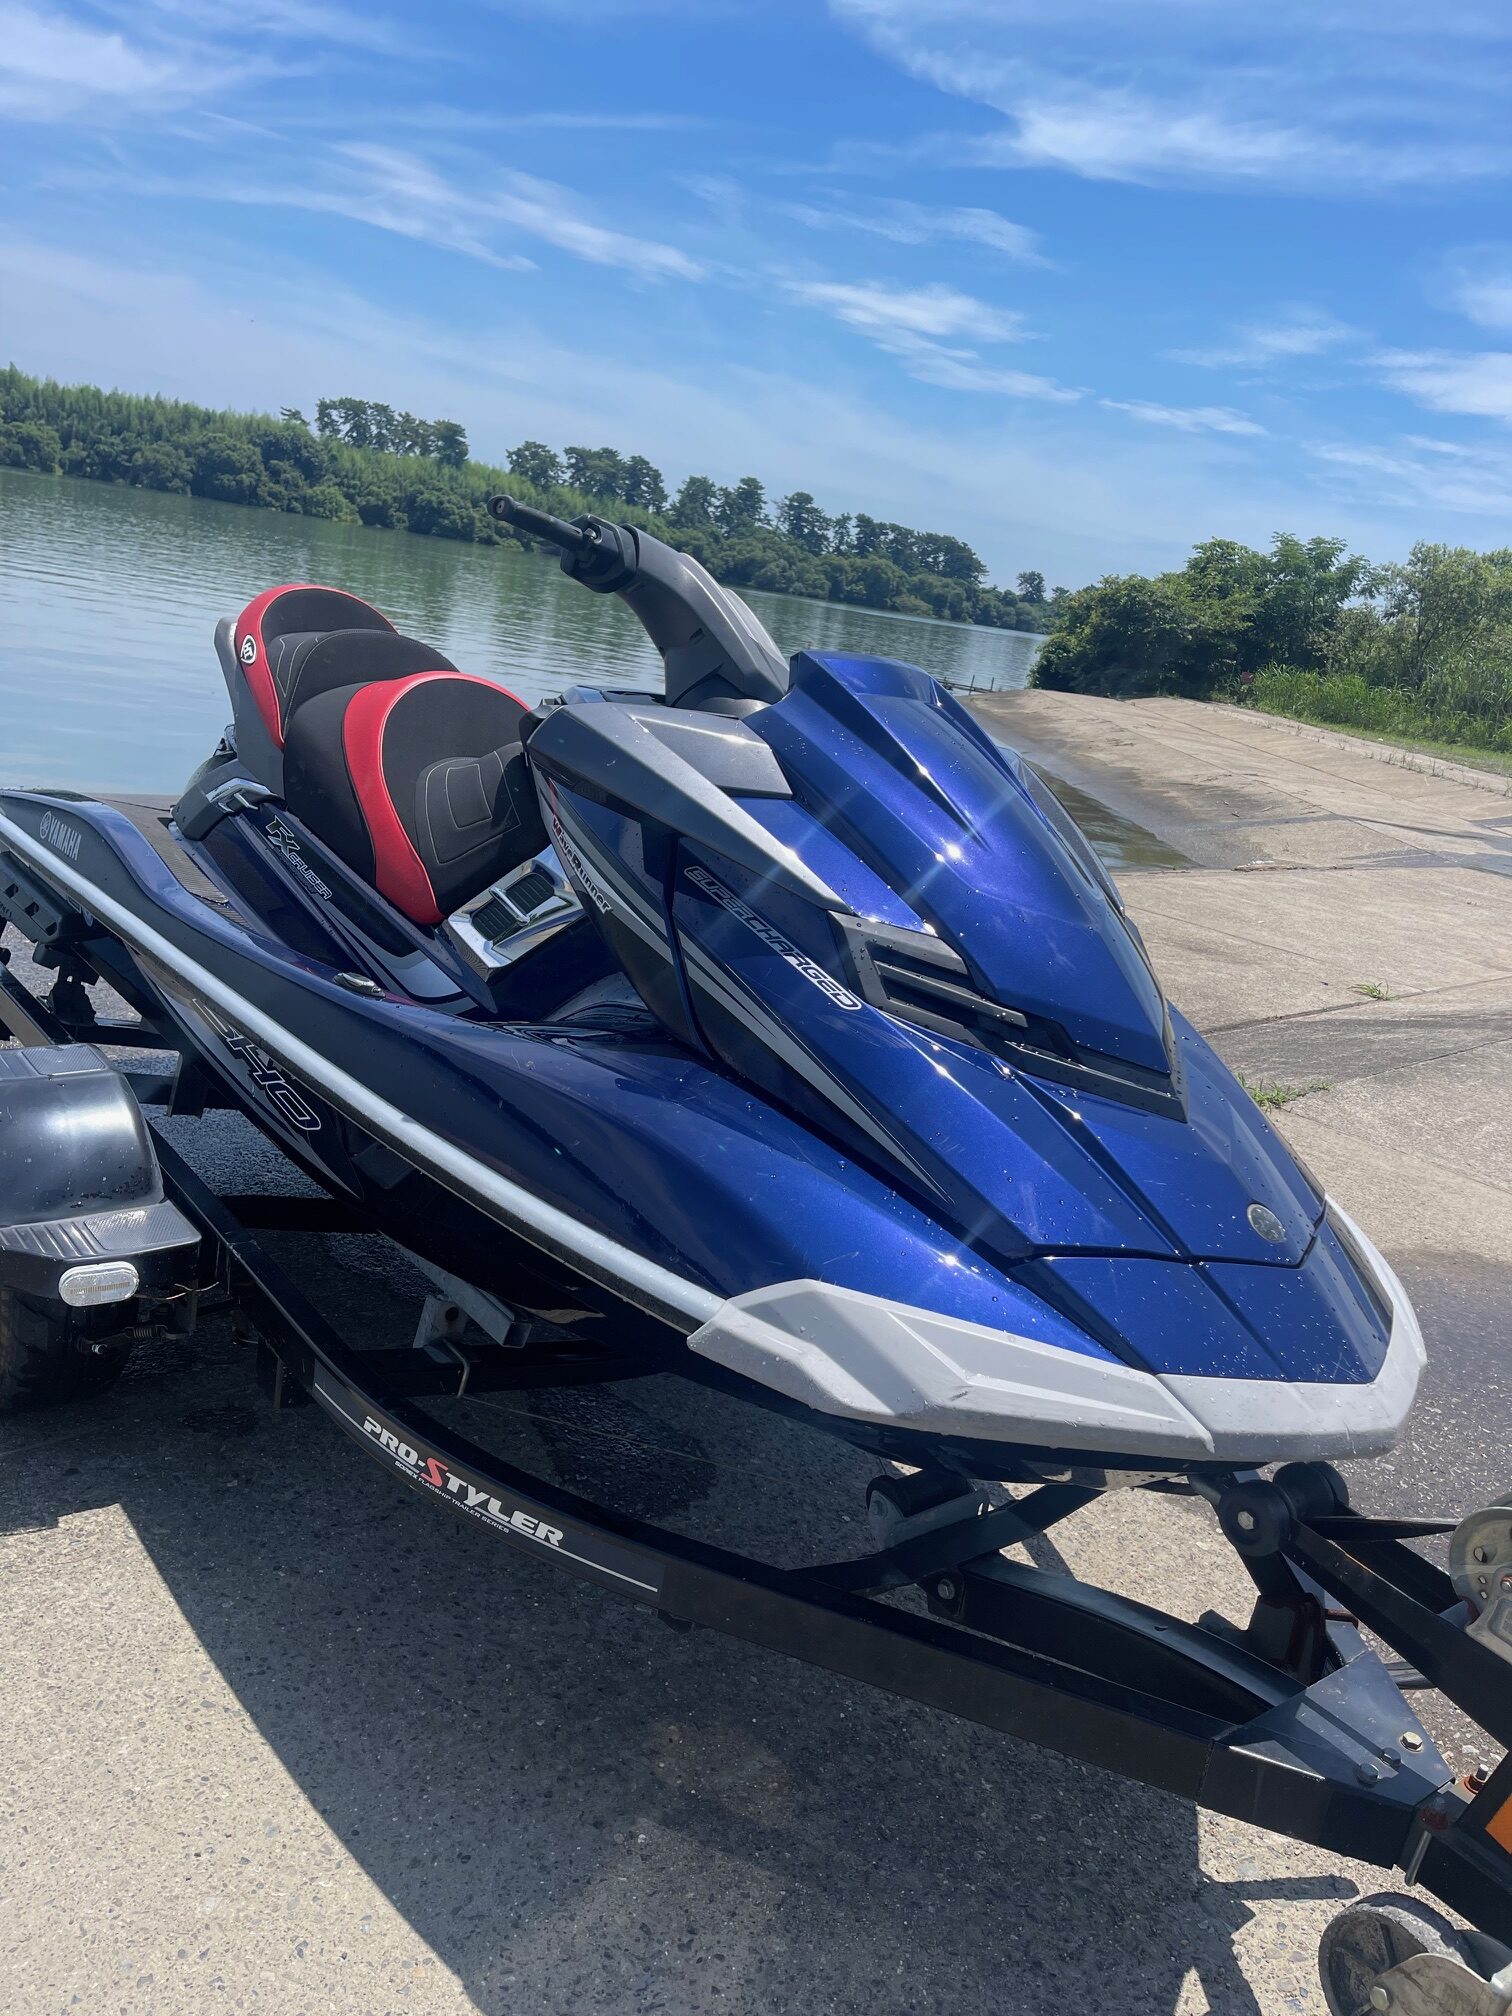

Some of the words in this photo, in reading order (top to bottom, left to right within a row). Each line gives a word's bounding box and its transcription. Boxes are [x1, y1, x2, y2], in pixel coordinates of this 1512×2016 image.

[48, 816, 81, 861] YAMAHA
[266, 815, 300, 858] FX
[288, 852, 332, 900] CRUISER
[552, 814, 612, 914] WaveRunner
[363, 1415, 563, 1547] PRO-STYLER
[394, 1461, 418, 1480] SOREX
[418, 1477, 452, 1501] FLAGSHIP
[451, 1497, 481, 1519] TRAILER
[481, 1515, 510, 1534] SERIES
